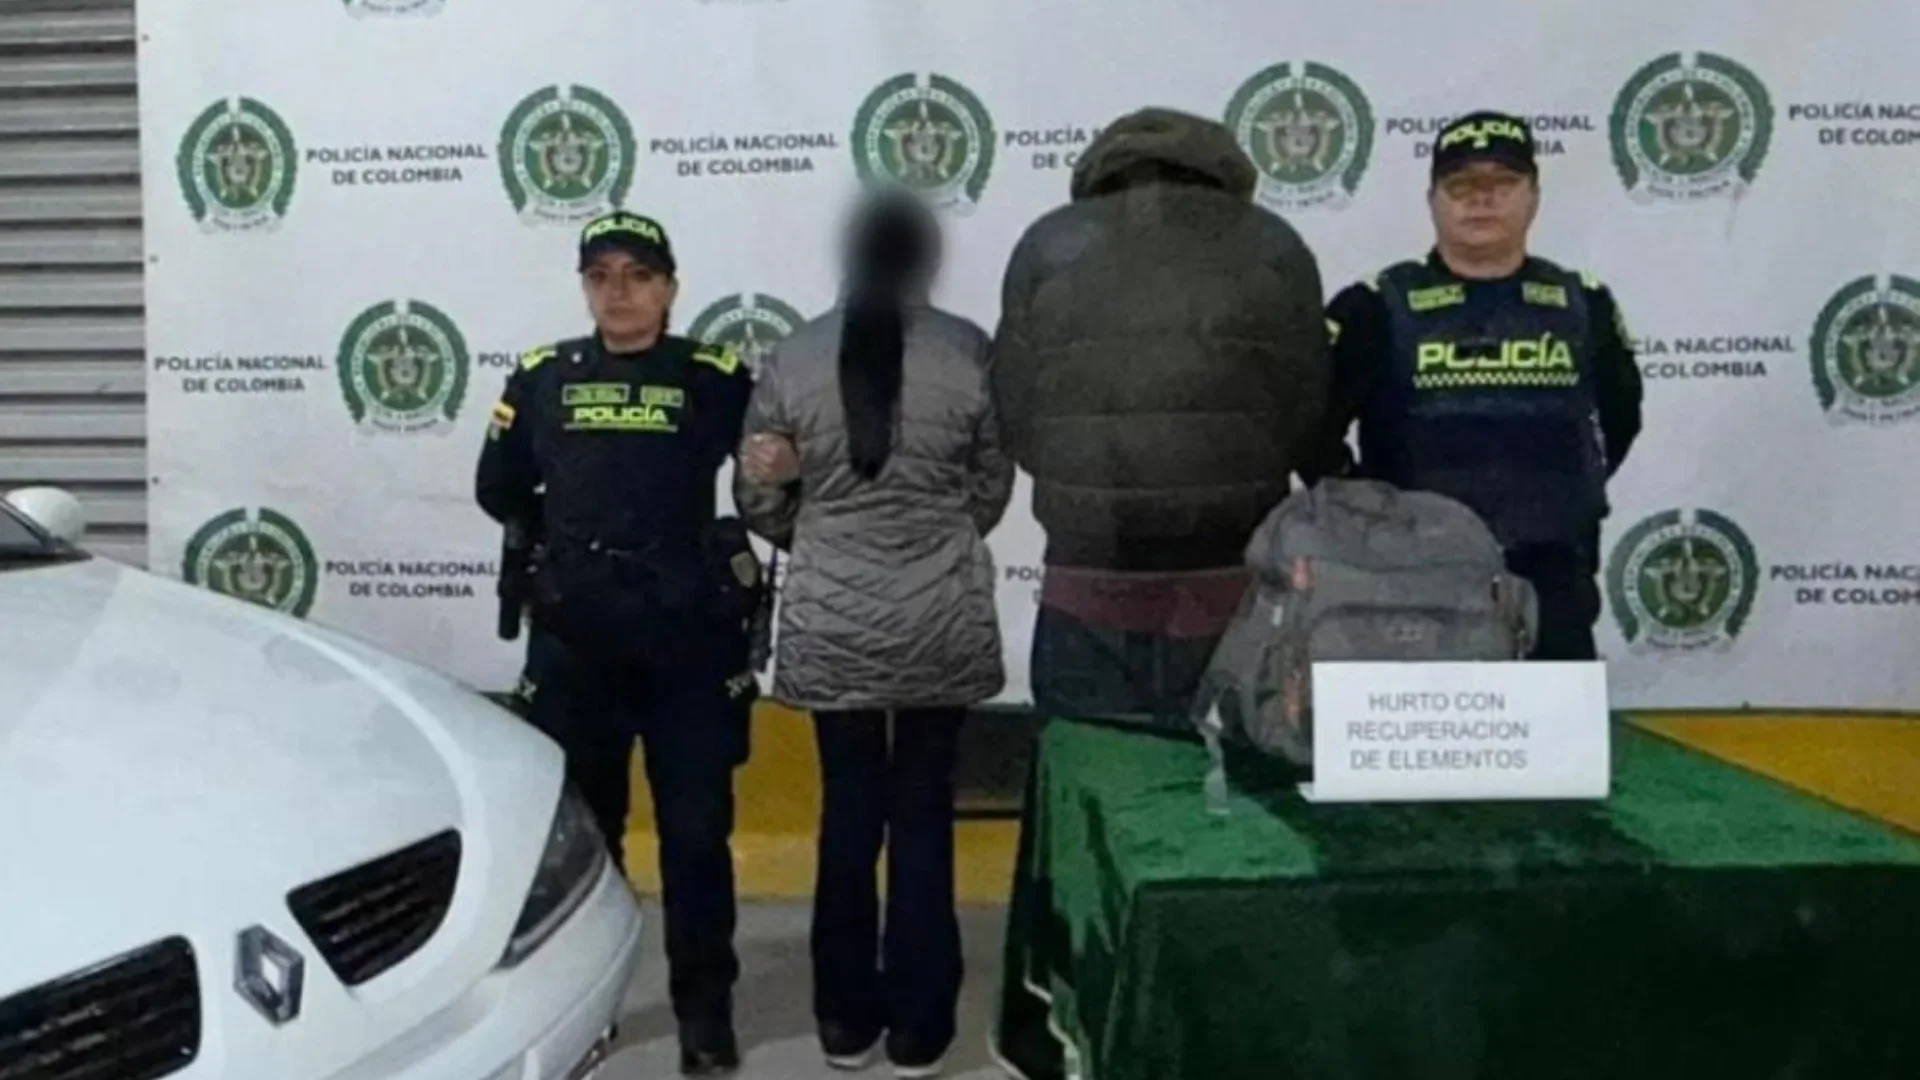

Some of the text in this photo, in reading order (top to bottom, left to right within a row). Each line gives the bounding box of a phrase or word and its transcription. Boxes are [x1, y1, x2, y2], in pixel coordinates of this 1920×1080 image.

[734, 132, 838, 152] NACIONAL
[1819, 127, 1920, 146] DE COLOM
[387, 143, 489, 161] NACIONAL
[1032, 152, 1058, 170] DE
[332, 165, 463, 185] DE COLOMBIA
[677, 156, 814, 177] DE COLOMBIA
[1674, 335, 1796, 354] NACIONAL
[237, 354, 328, 371] NACIONAL
[1642, 361, 1768, 380] COLOMBIA
[183, 376, 306, 394] DE COLOMBIA
[573, 403, 669, 425] POLICÍA
[399, 560, 500, 577] NACIONAL
[349, 581, 475, 598] DE COLOMBIA
[1796, 587, 1920, 606] DE COLOM
[1368, 691, 1506, 712] HURTO CON
[1347, 719, 1531, 742] RECUPERACION
[1350, 747, 1530, 771] DE ELEMENTOS
